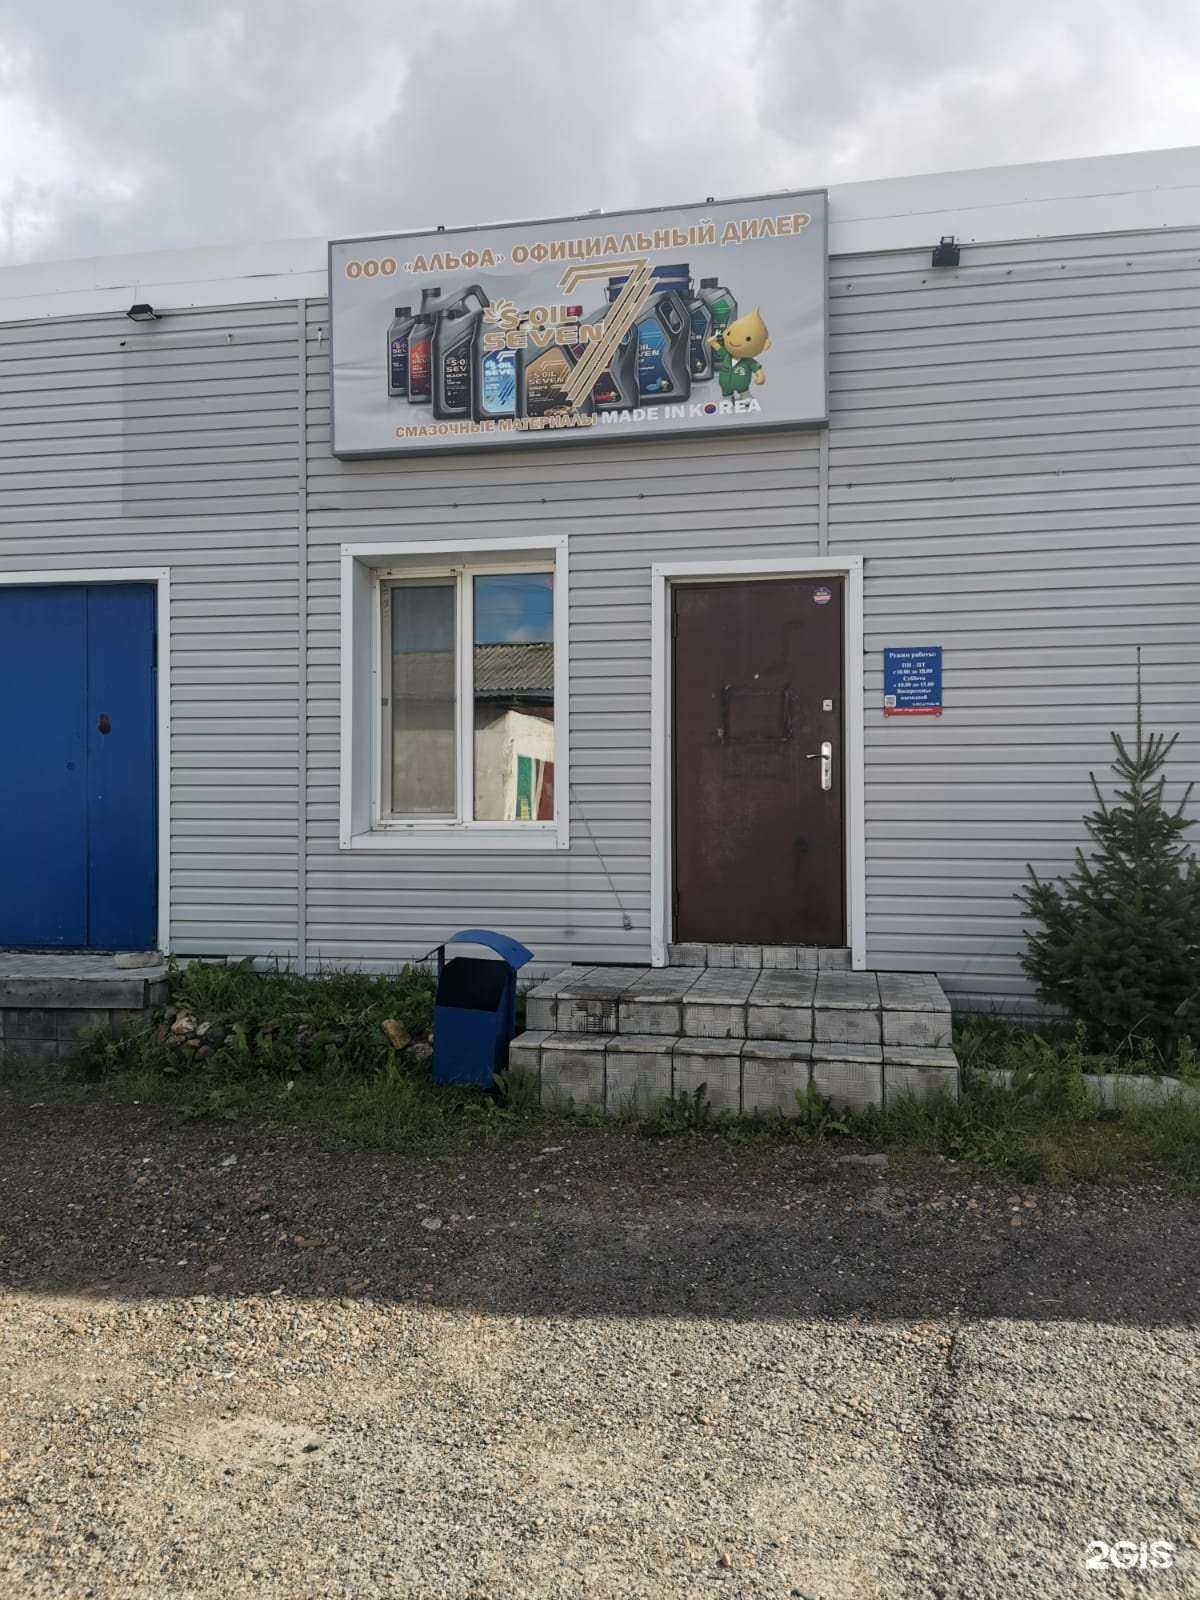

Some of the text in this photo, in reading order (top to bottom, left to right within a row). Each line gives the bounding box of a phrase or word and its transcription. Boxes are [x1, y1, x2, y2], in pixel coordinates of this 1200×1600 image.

[345, 212, 811, 280] ООО «АЛЬФА» ОФИЦИАЛЬНЫЙ ДИЛЕР
[483, 324, 605, 352] SEVEN
[601, 398, 762, 425] MADE IN KOREA
[394, 413, 597, 439] СМАЗОЧНЫЕ МАТЕРИАЛЫ
